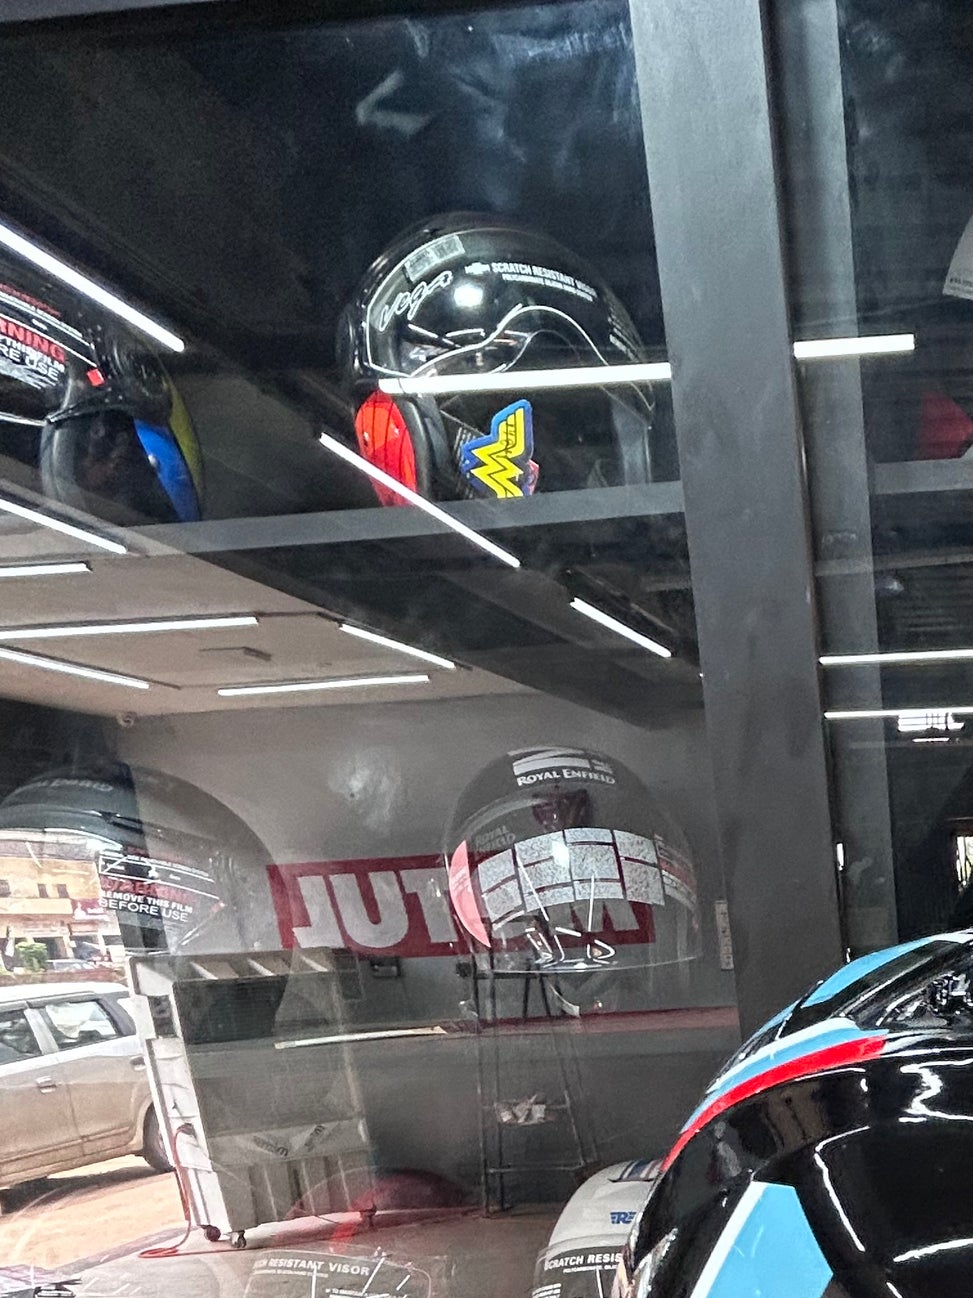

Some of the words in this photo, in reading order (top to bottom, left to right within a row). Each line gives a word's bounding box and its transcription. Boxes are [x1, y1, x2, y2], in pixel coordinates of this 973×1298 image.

[0, 318, 66, 365] NING
[516, 770, 561, 786] ROYAL
[562, 768, 616, 785] ENFIELD
[99, 899, 159, 916] BEFORE
[161, 909, 188, 922] USE
[101, 891, 145, 904] REMOVE
[147, 896, 170, 909] THIS
[171, 901, 193, 914] FILM
[268, 1257, 324, 1271] RESISTANT
[328, 1262, 370, 1276] VISOR
[544, 1254, 584, 1271] SCRATCH
[587, 1252, 622, 1264] RESIS
